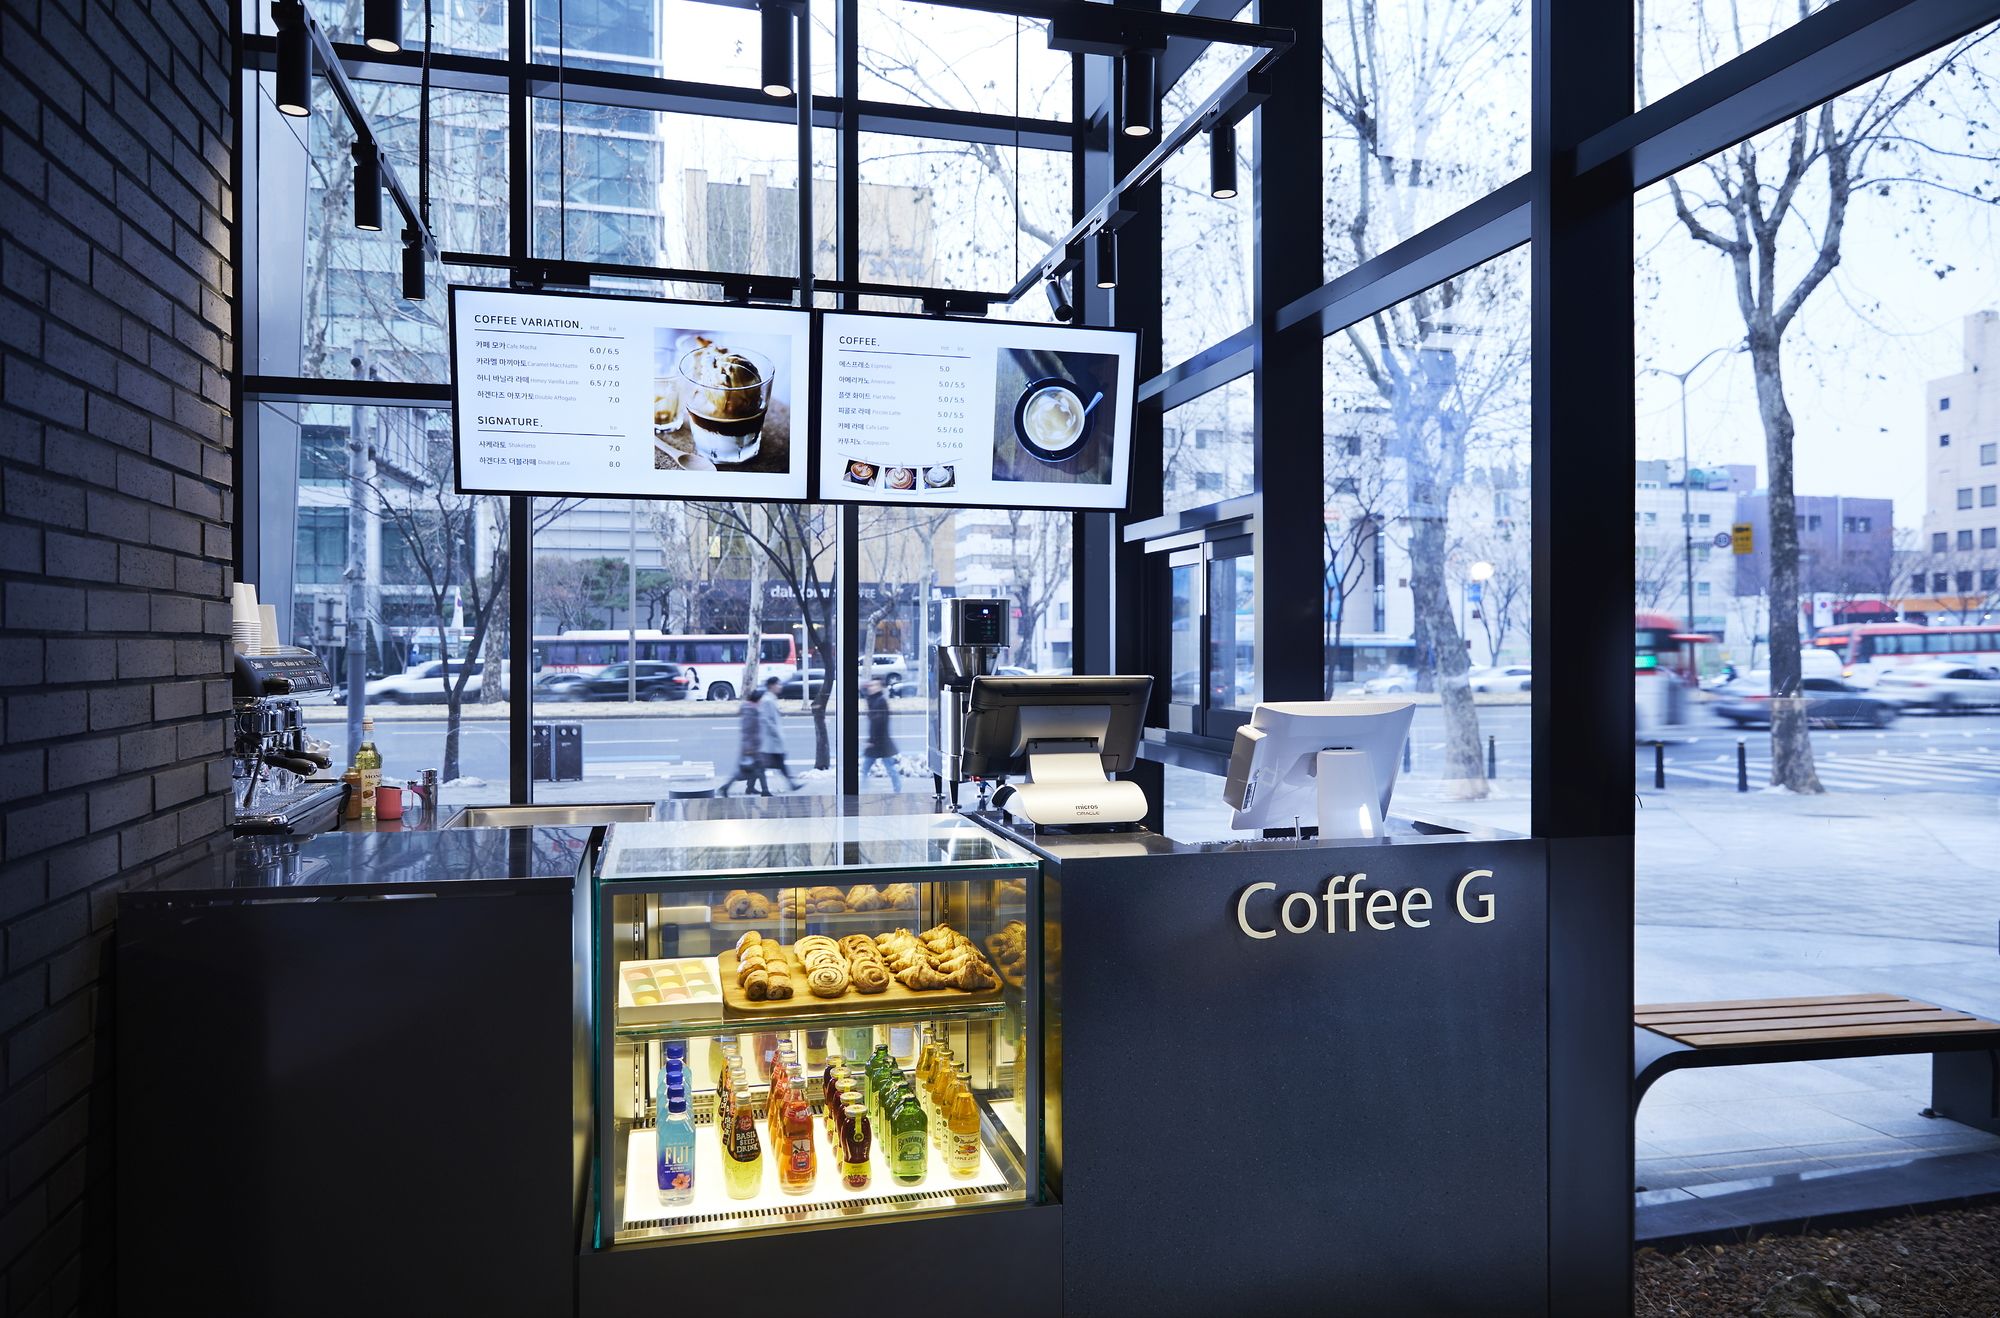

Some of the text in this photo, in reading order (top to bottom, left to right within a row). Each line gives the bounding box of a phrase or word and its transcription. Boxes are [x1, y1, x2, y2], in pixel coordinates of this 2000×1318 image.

[474, 314, 584, 330] COFFEE VARIATION.
[475, 341, 490, 349] 카페
[492, 341, 506, 350] 모카
[839, 336, 880, 347] COFFEE.
[839, 376, 870, 384] 아메리카노
[477, 390, 505, 399] 하겐다즈
[477, 416, 544, 428] SIGNATURE.
[479, 457, 508, 465] 하겐다즈
[1238, 870, 1495, 940] Coffee G
[736, 1131, 756, 1141] BASIL
[736, 1144, 758, 1153] DRINK
[664, 1146, 689, 1164] FIJI
